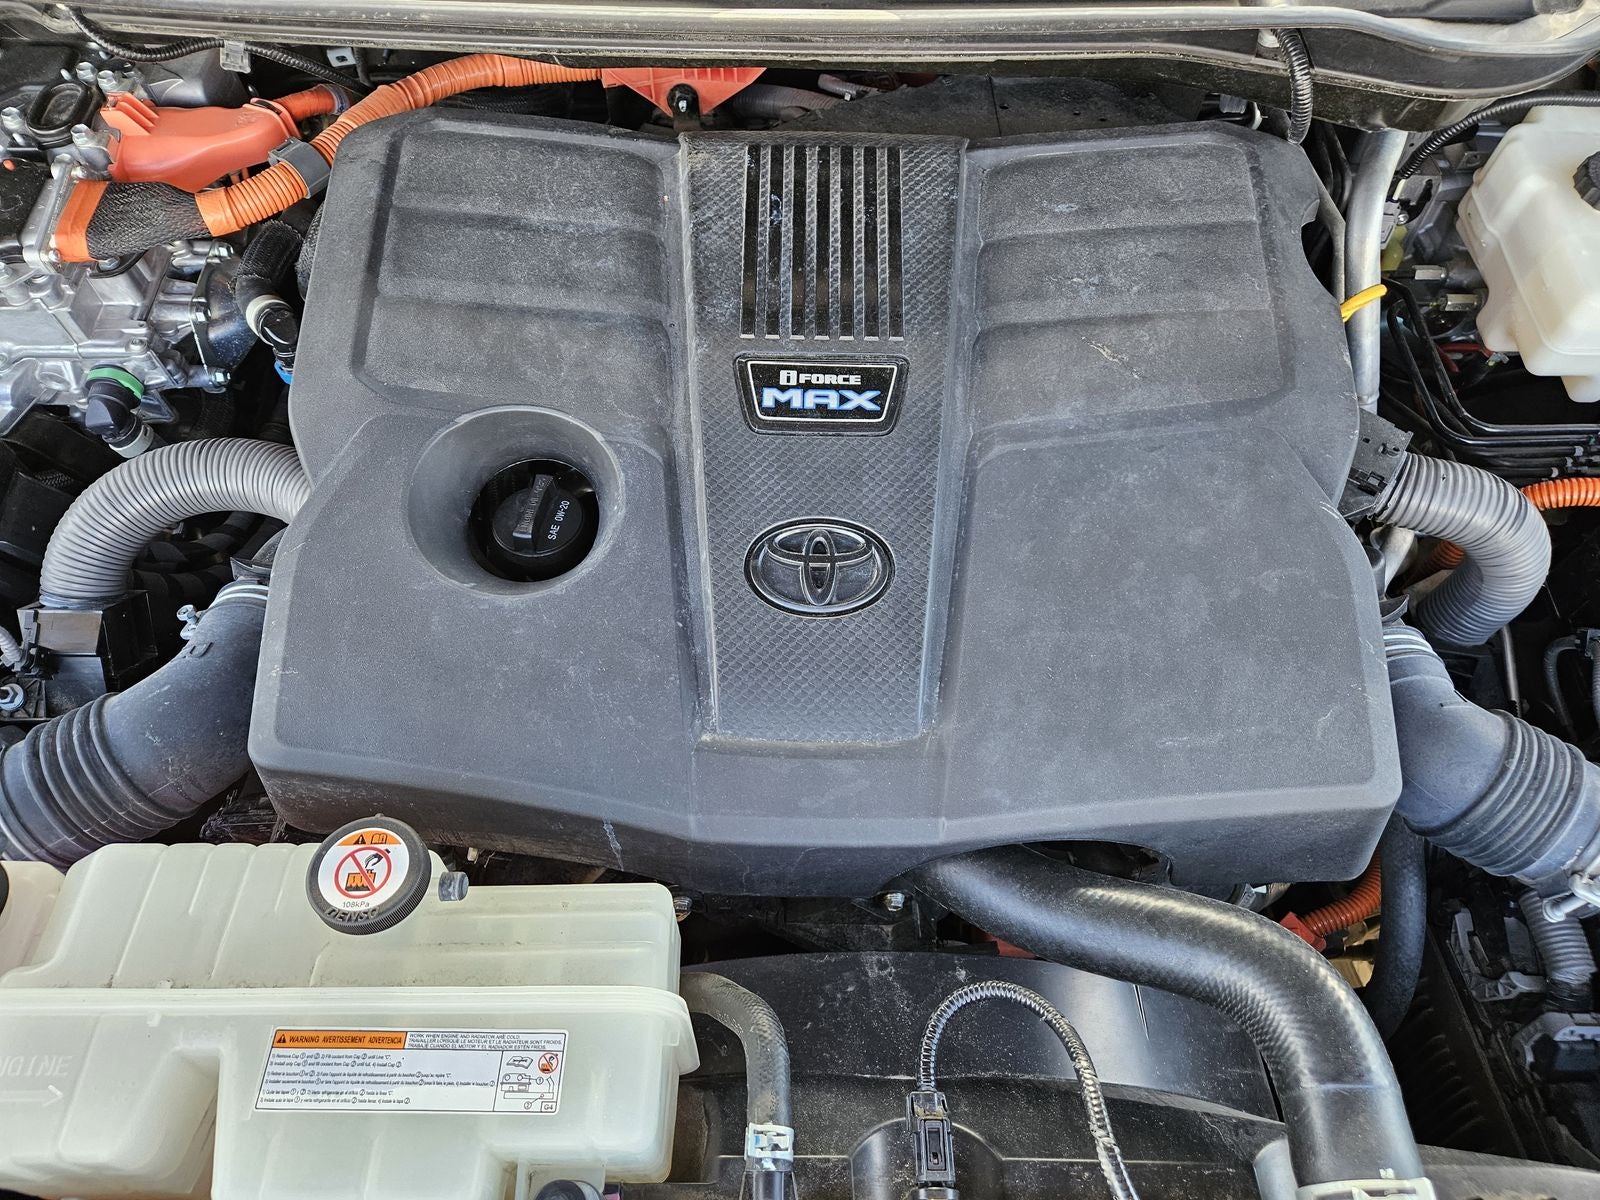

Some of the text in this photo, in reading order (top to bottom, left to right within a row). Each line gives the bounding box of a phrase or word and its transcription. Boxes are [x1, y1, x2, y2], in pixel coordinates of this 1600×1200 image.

[762, 387, 881, 411] MAX
[547, 500, 570, 540] SAE 0W-20
[342, 900, 370, 908] 108kPa
[325, 907, 380, 923] DENSO
[289, 1035, 402, 1044] WARNING AVERTISSEMENT ADVERTENCIA
